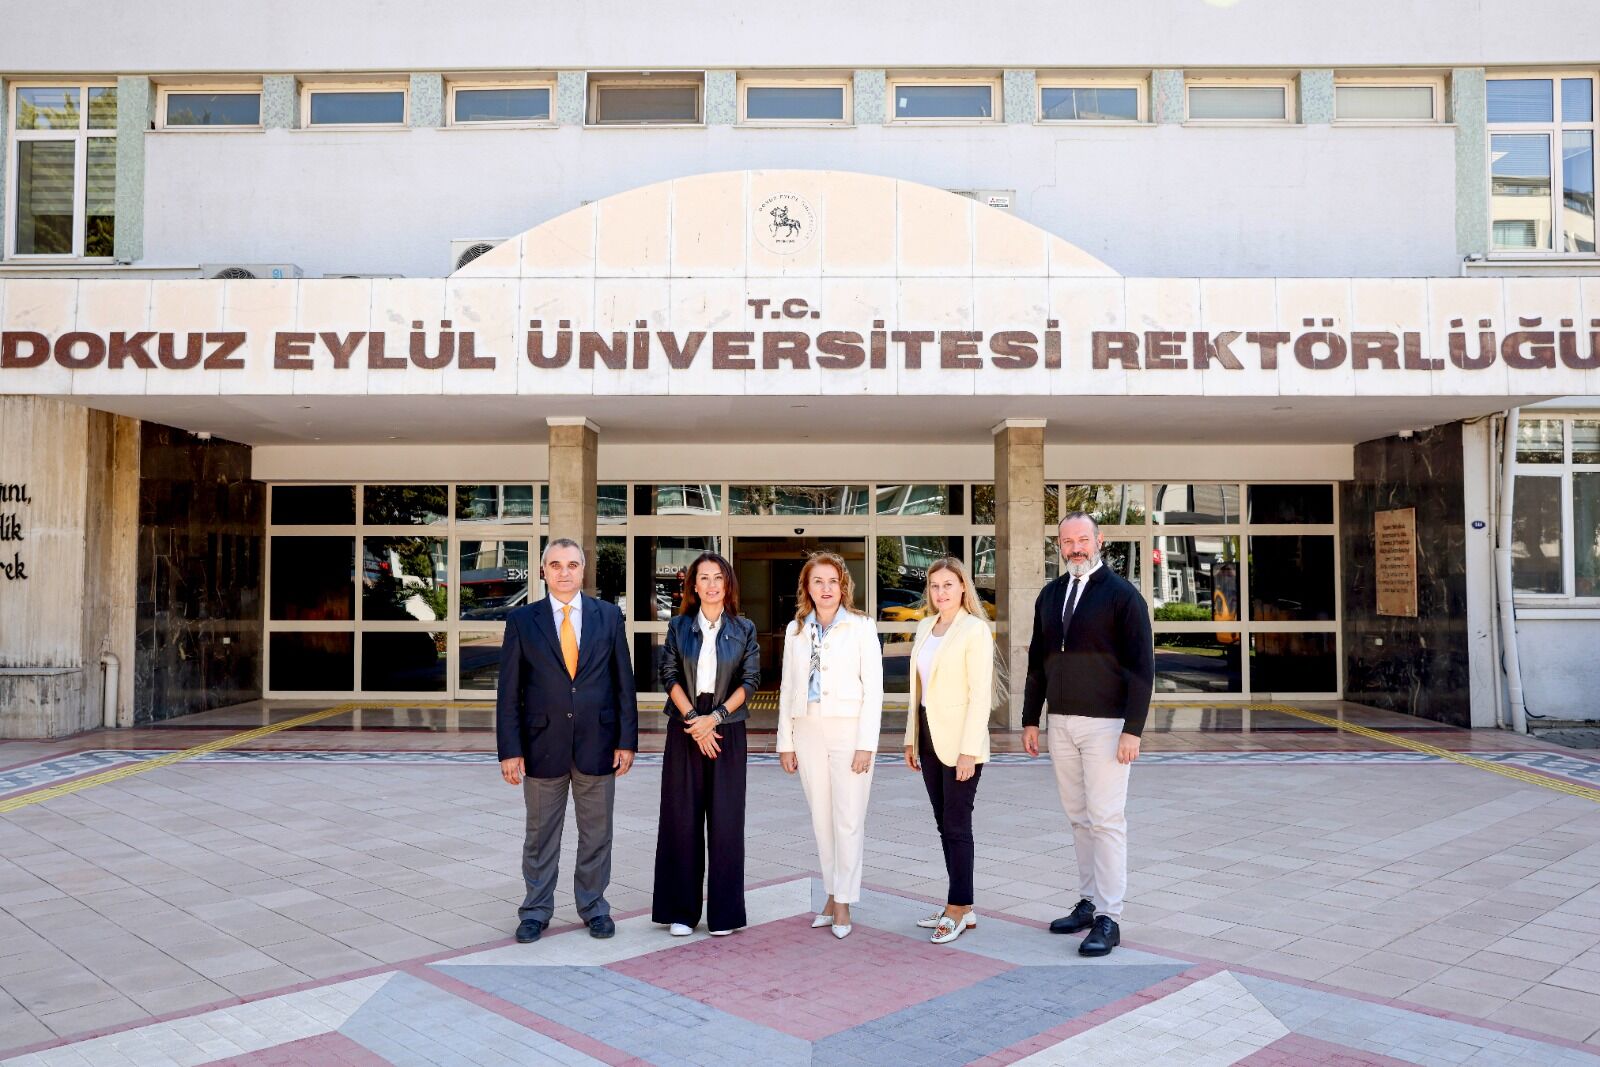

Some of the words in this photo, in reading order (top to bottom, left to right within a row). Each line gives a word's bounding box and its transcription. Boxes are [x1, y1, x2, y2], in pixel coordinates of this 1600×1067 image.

[747, 298, 820, 319] T.C.
[1, 331, 247, 370] DOKUZ
[274, 319, 497, 371] EYLÜL
[526, 319, 1062, 370] ÜNİVERSİTESİ
[1092, 317, 1600, 370] REKTÖRLÜĞÜ
[0, 482, 31, 504] ını,
